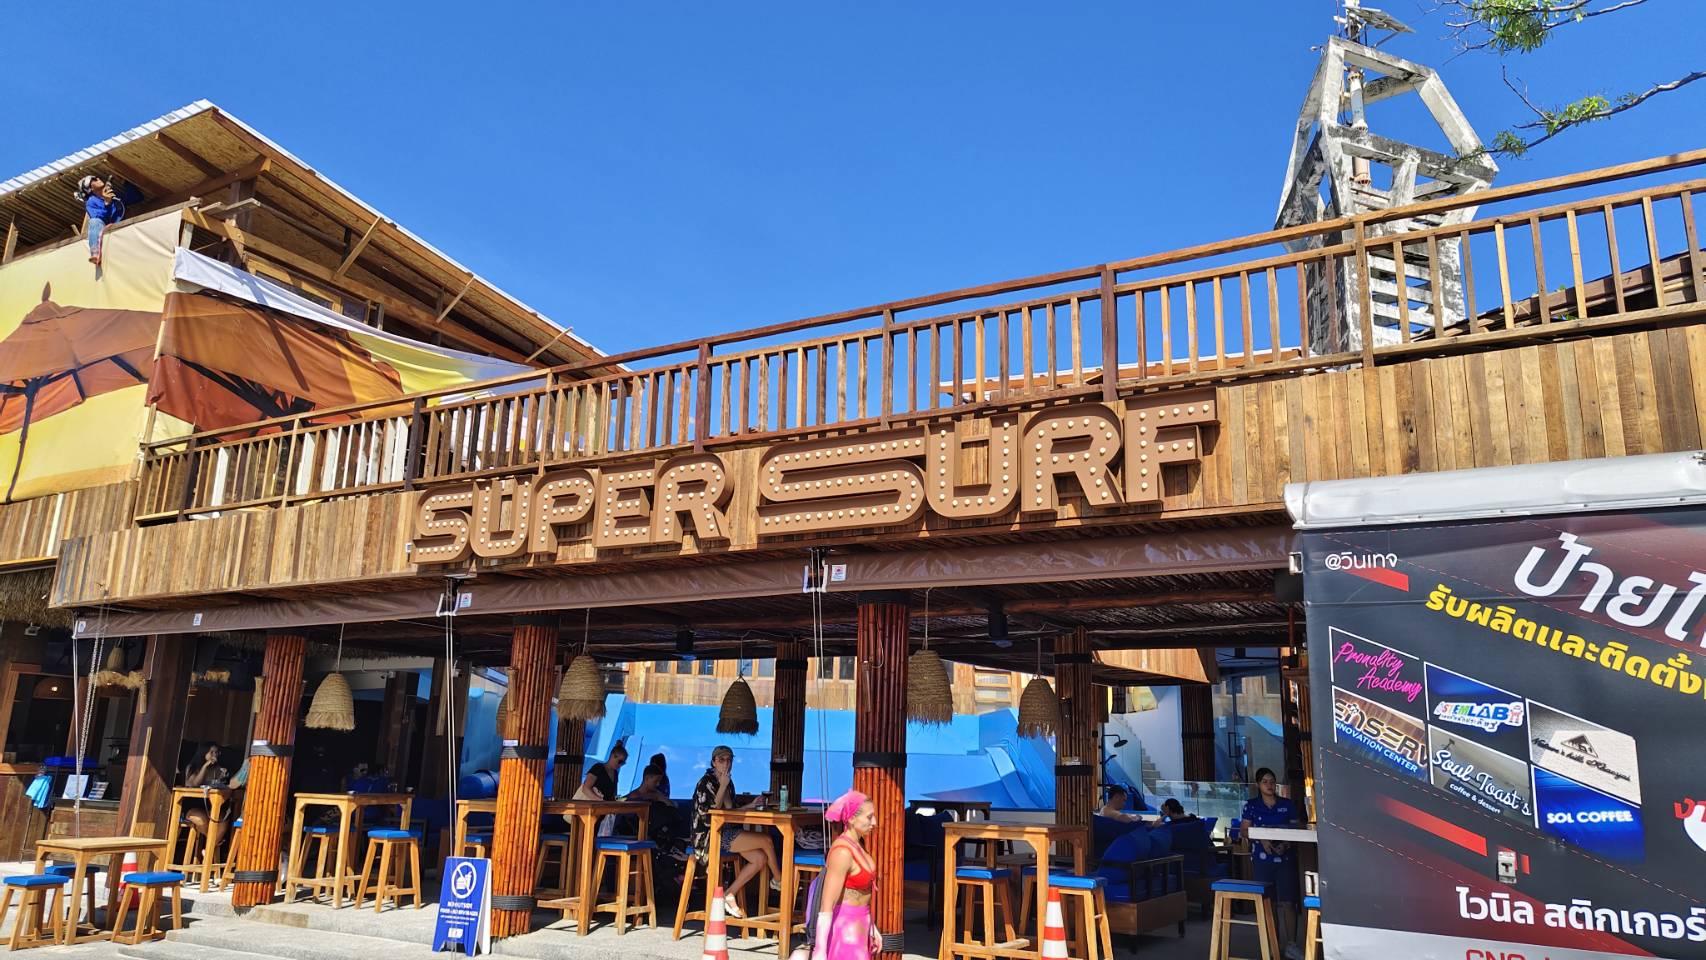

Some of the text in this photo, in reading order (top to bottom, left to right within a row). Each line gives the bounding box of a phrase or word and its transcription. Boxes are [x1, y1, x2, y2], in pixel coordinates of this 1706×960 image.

[411, 389, 1220, 563] SUPER SURF
[1325, 551, 1398, 571] @วินเทจ
[1357, 667, 1423, 703] Academy
[1383, 749, 1418, 773] CENTER
[1432, 749, 1474, 781] Soul
[1449, 783, 1471, 798] coffee
[1471, 794, 1478, 802] &
[1547, 810, 1634, 824] SOL COFFEE
[1456, 886, 1535, 925] ไวนิล
